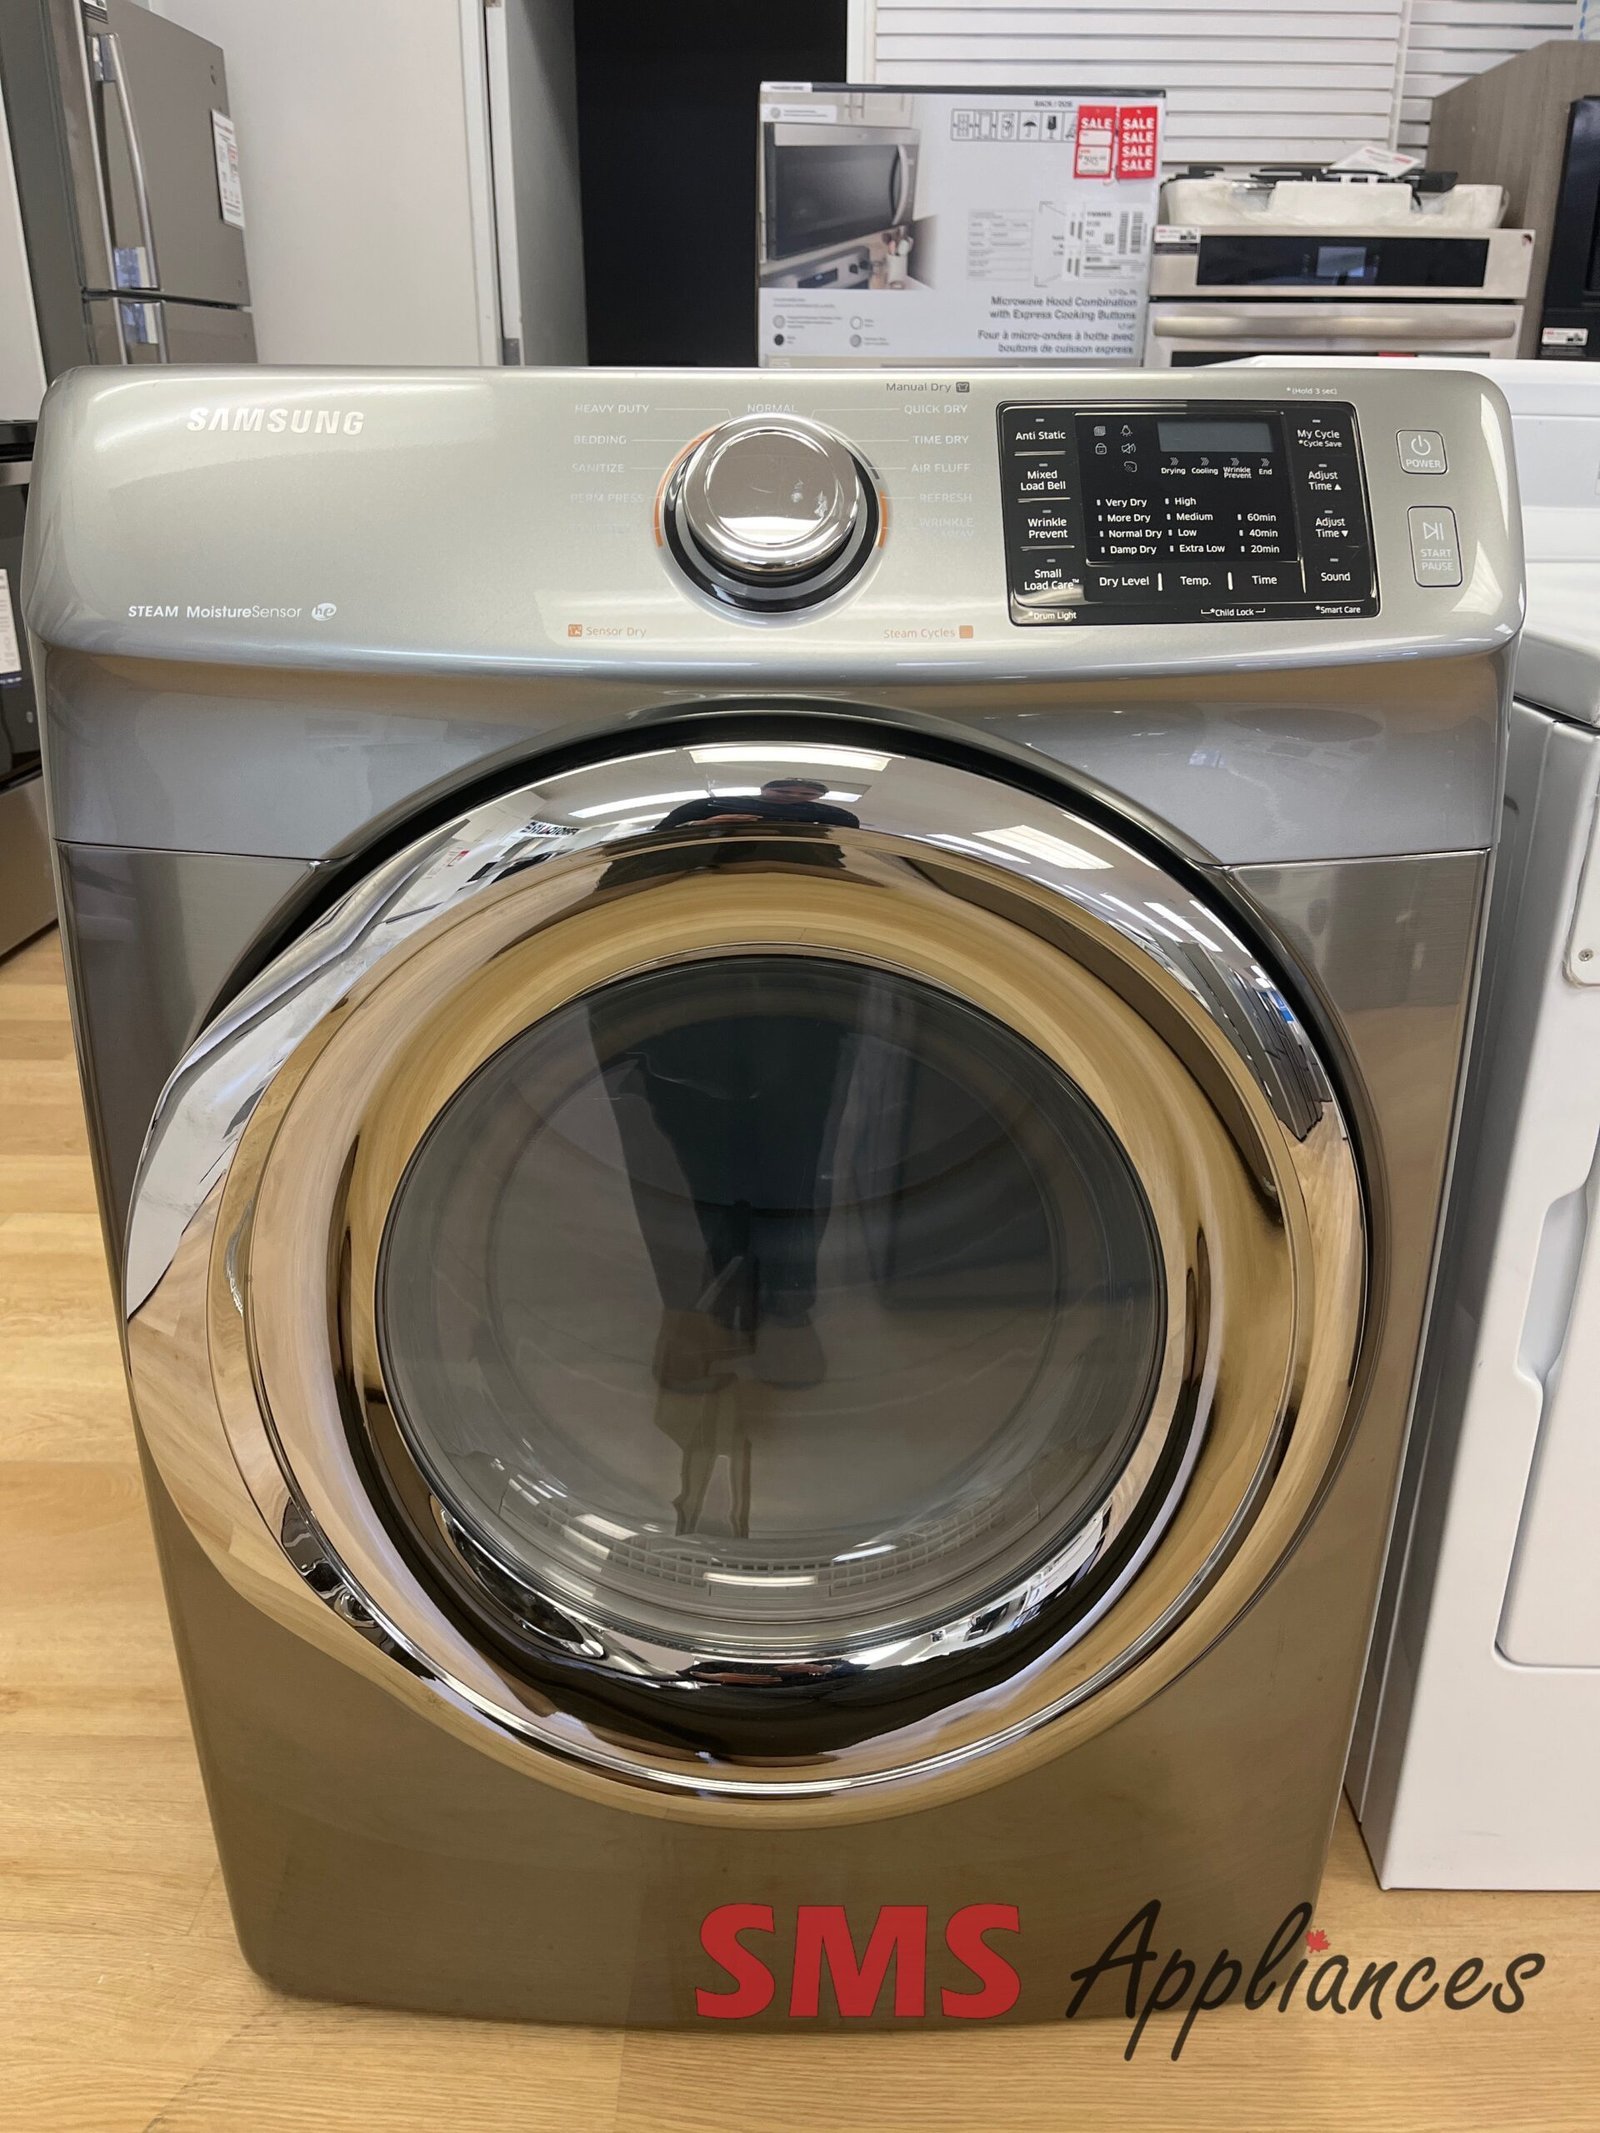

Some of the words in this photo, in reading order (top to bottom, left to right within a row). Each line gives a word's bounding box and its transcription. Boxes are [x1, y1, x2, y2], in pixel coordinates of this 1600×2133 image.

[1080, 117, 1112, 129] SALE
[1122, 118, 1154, 130] SALE
[1122, 131, 1154, 143] SALE
[1121, 145, 1153, 157] SALE
[1121, 159, 1152, 171] SALE
[991, 296, 1043, 306] Microwave
[1046, 296, 1073, 306] Hood
[1075, 296, 1137, 306] Combination
[990, 310, 1011, 319] with
[1013, 310, 1051, 321] Express
[1054, 310, 1095, 321] Cooking
[1098, 310, 1136, 320] Buttons
[977, 330, 1000, 340] Four
[1011, 331, 1072, 341] micro-ondes
[1083, 331, 1109, 341] hotte
[998, 344, 1038, 352] boutons
[1040, 344, 1051, 352] de
[1055, 345, 1093, 353] cuisson
[1095, 346, 1134, 355] express
[886, 382, 927, 392] Manual
[930, 382, 952, 393] Dry
[575, 404, 614, 413] HEAVY
[618, 404, 649, 413] DUTY
[747, 403, 798, 413] NORMAL
[904, 404, 940, 415] QUICK
[943, 404, 968, 414] DRY
[186, 407, 364, 436] SAMSUNG
[1015, 431, 1036, 441] Anti
[1038, 430, 1066, 440] Static
[1297, 429, 1312, 439] My
[1314, 429, 1340, 439] Cycle
[574, 435, 627, 445] BEDDING
[912, 435, 942, 445] TIME
[945, 435, 969, 445] DRY
[1324, 440, 1342, 448] Save
[571, 463, 625, 473] SANITIZE
[911, 464, 931, 473] AIR
[934, 464, 972, 473] FLUFF
[1406, 459, 1441, 468] POWER
[1027, 470, 1058, 479] Mixed
[1161, 467, 1186, 475] Drying
[1191, 467, 1219, 475] Cooling
[1308, 471, 1338, 481] Adjust
[1020, 481, 1045, 491] Load
[1047, 480, 1066, 490] Bell
[1308, 481, 1333, 491] Time
[920, 493, 972, 503] REFRESH
[1105, 498, 1127, 508] Very
[1130, 498, 1148, 508] Dry
[1174, 497, 1197, 507] High
[1107, 514, 1131, 522] More
[1133, 513, 1151, 523] Dry
[1176, 512, 1213, 521] Medium
[1247, 513, 1277, 522] 60min
[919, 518, 975, 528] WRINKLE
[1028, 518, 1067, 527] Wrinkle
[1315, 517, 1345, 528] Adjust
[1028, 529, 1068, 539] Prevent
[1109, 529, 1142, 538] Normal
[1144, 529, 1162, 539] Dry
[1177, 528, 1197, 537] Low
[1249, 529, 1278, 538] 40min
[1315, 529, 1339, 538] Time
[1110, 545, 1137, 555] Damp
[1139, 545, 1157, 555] Dry
[1179, 545, 1204, 553] Extra
[1206, 544, 1226, 553] Low
[1250, 545, 1280, 553] 20min
[1420, 549, 1452, 557] START
[1421, 562, 1453, 571] PAUSE
[1034, 568, 1062, 579] Small
[1320, 572, 1351, 582] Sound
[1099, 577, 1119, 588] Dry
[1121, 576, 1149, 586] Level
[1180, 576, 1211, 587] Temp.
[1251, 575, 1278, 585] Time
[1024, 580, 1049, 591] Load
[128, 605, 179, 618] STEAM
[186, 605, 302, 618] MoistureSensor
[1236, 608, 1254, 617] Lock
[1344, 605, 1361, 614] Care
[1057, 611, 1077, 621] Light
[586, 626, 622, 636] Sensor
[626, 626, 647, 638] Dry
[883, 629, 917, 639] Steam
[920, 628, 956, 639] Cycles
